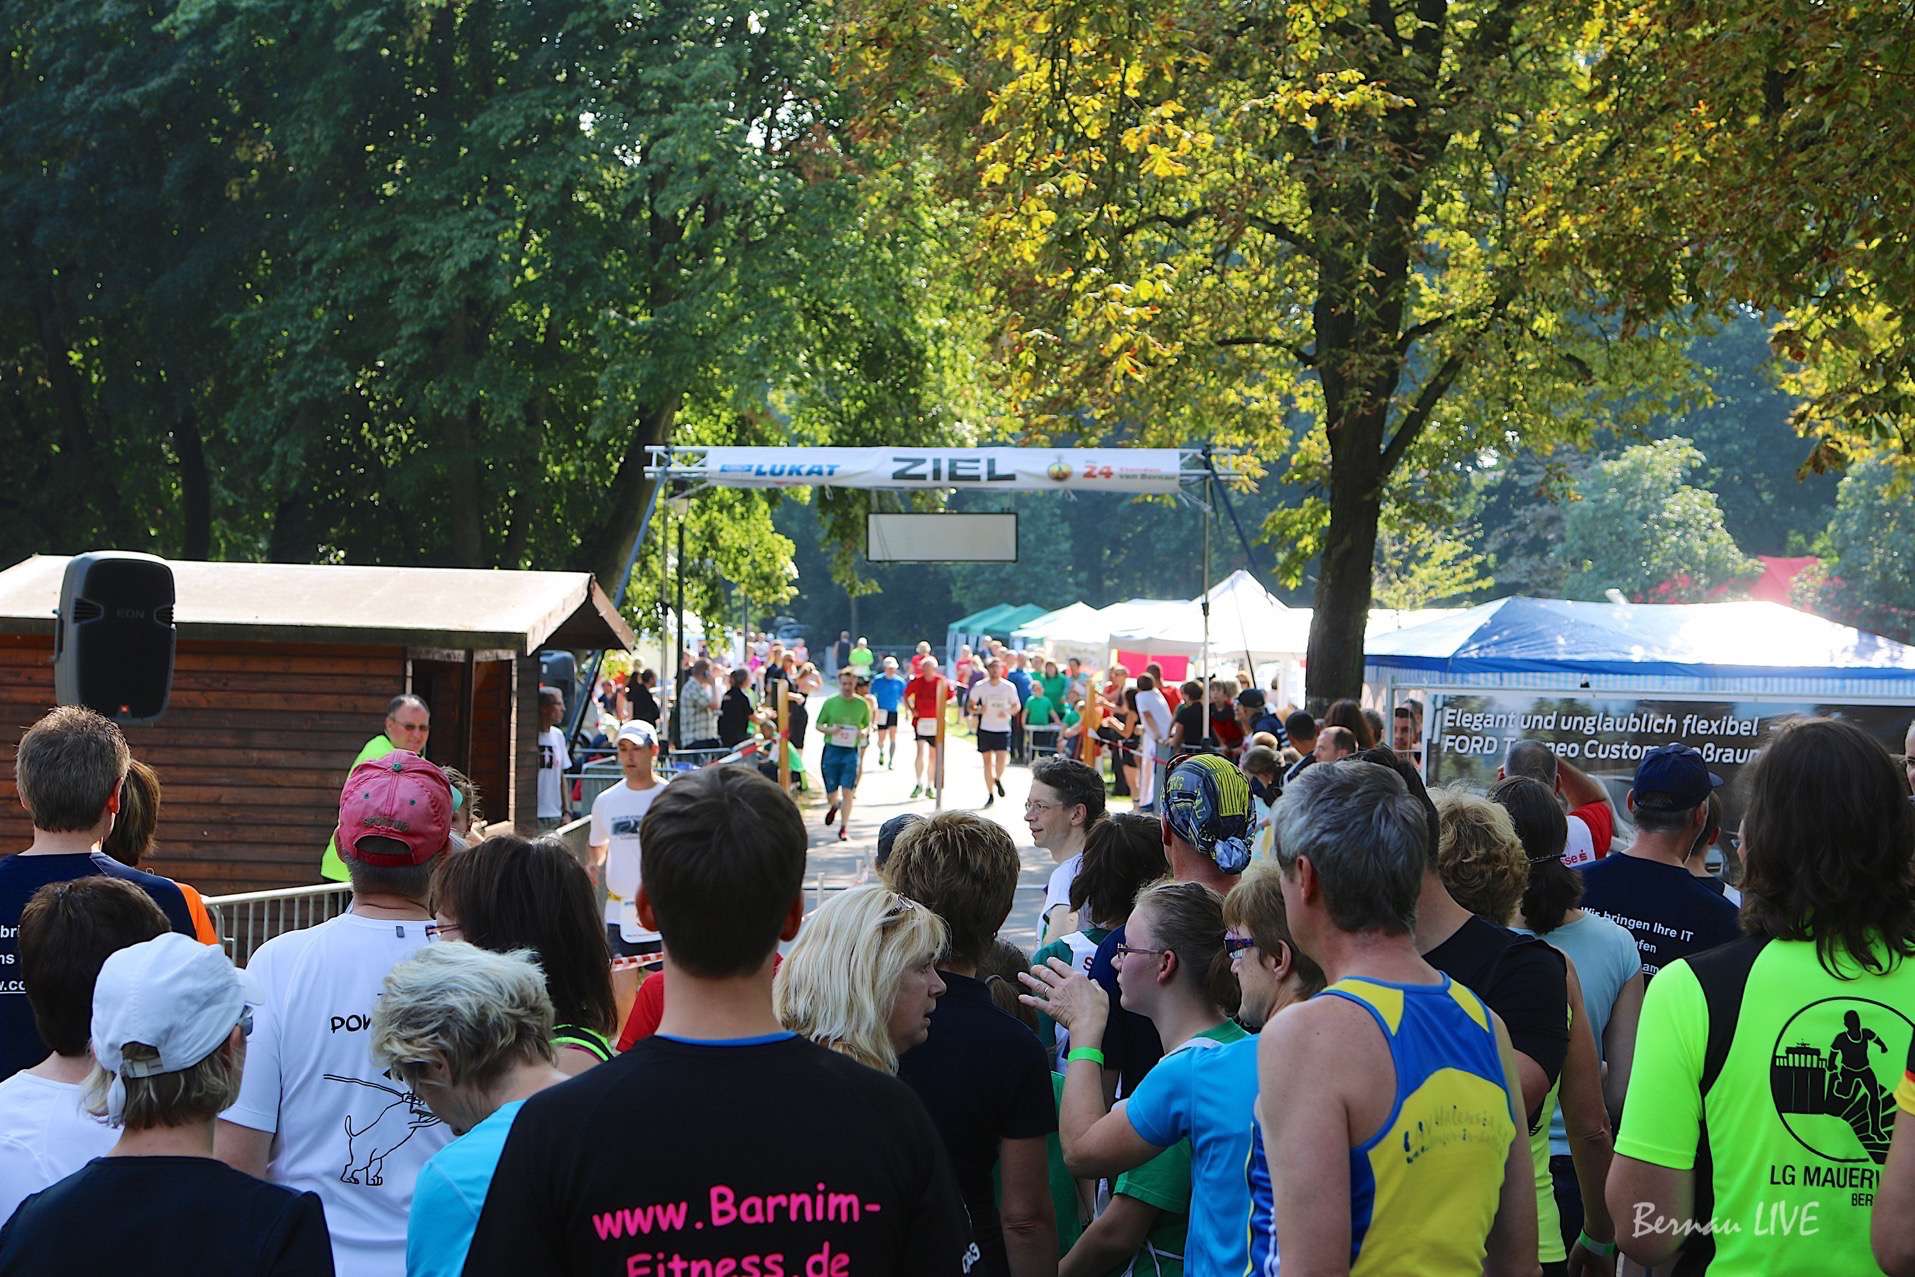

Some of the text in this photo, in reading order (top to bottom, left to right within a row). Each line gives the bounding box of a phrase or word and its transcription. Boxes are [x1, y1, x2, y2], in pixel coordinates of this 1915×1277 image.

[754, 464, 840, 477] LUKAT
[892, 457, 1017, 481] ZIEL
[1083, 465, 1114, 479] 24
[1444, 708, 1760, 738] Elegant und unglaublich flexibel
[1443, 735, 1498, 754] FORD
[1503, 736, 1580, 758] Tneo
[1603, 910, 1651, 931] bringen
[1653, 922, 1678, 938] Ihre
[1680, 929, 1694, 942] IT
[1635, 939, 1657, 954] fen
[1769, 1164, 1796, 1186] LG
[626, 1240, 851, 1277] Fitnessde
